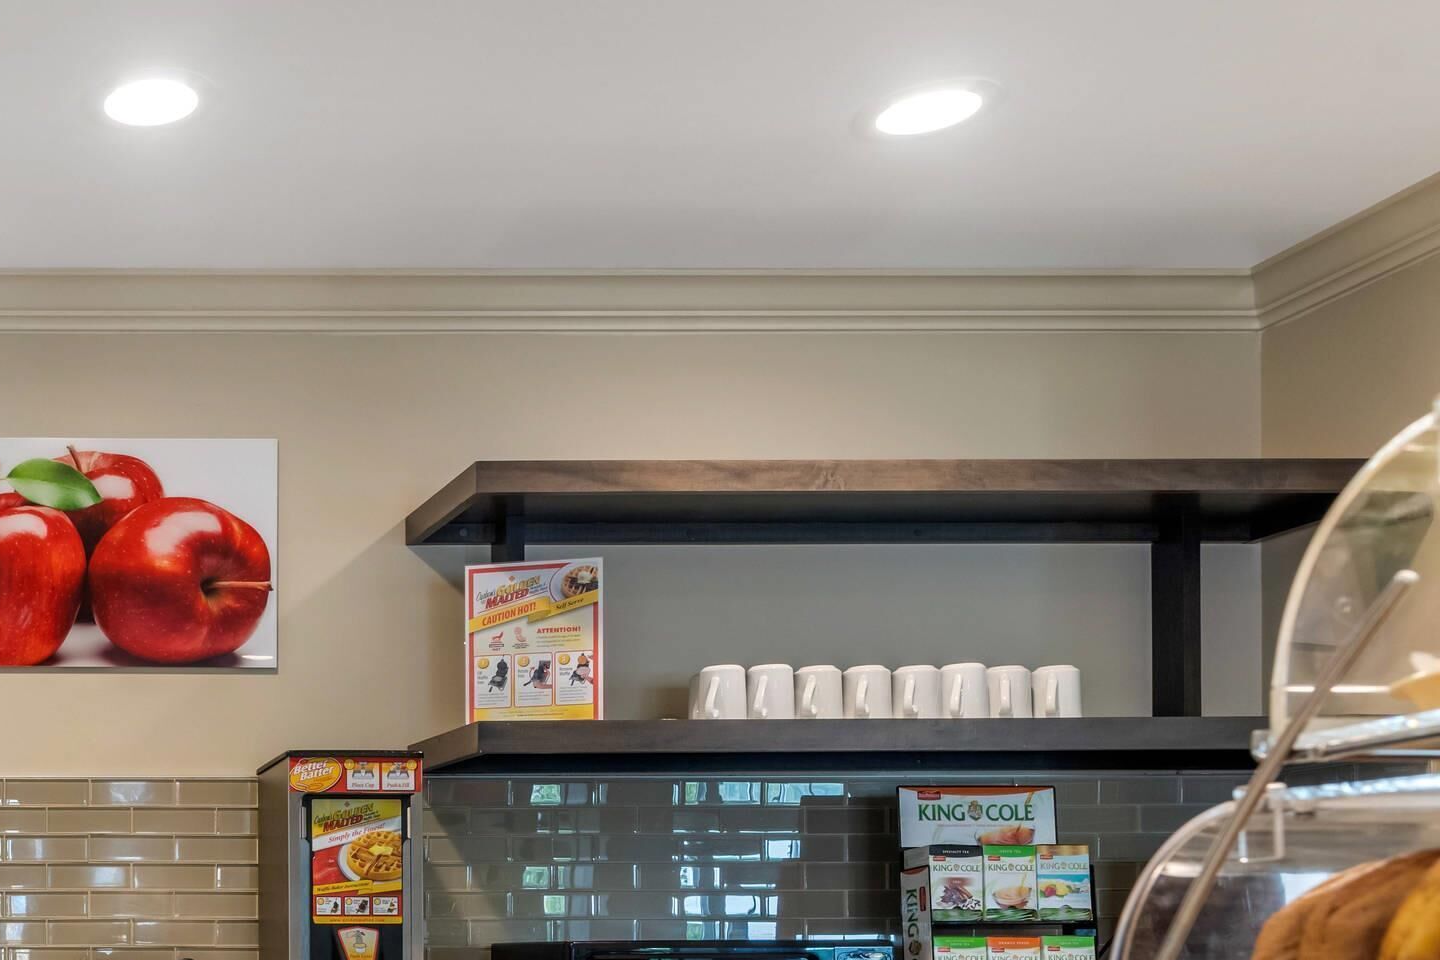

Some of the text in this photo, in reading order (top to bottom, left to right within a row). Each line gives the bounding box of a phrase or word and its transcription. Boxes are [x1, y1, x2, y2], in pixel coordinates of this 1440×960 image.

[496, 575, 541, 597] GOLDEN
[485, 587, 530, 609] MALTED
[482, 601, 537, 626] CAUTION HOT!
[536, 626, 582, 634] ATTENTION!
[294, 760, 329, 775] Better
[300, 766, 336, 782] Batter
[918, 803, 1035, 822] KING COLE
[323, 813, 364, 832] MALTED
[328, 832, 351, 843] Simply
[351, 829, 363, 837] the
[933, 864, 981, 872] KING COLE
[988, 863, 1035, 872] KING COLE
[1040, 862, 1089, 871] KING COLE
[906, 888, 920, 938] KING
